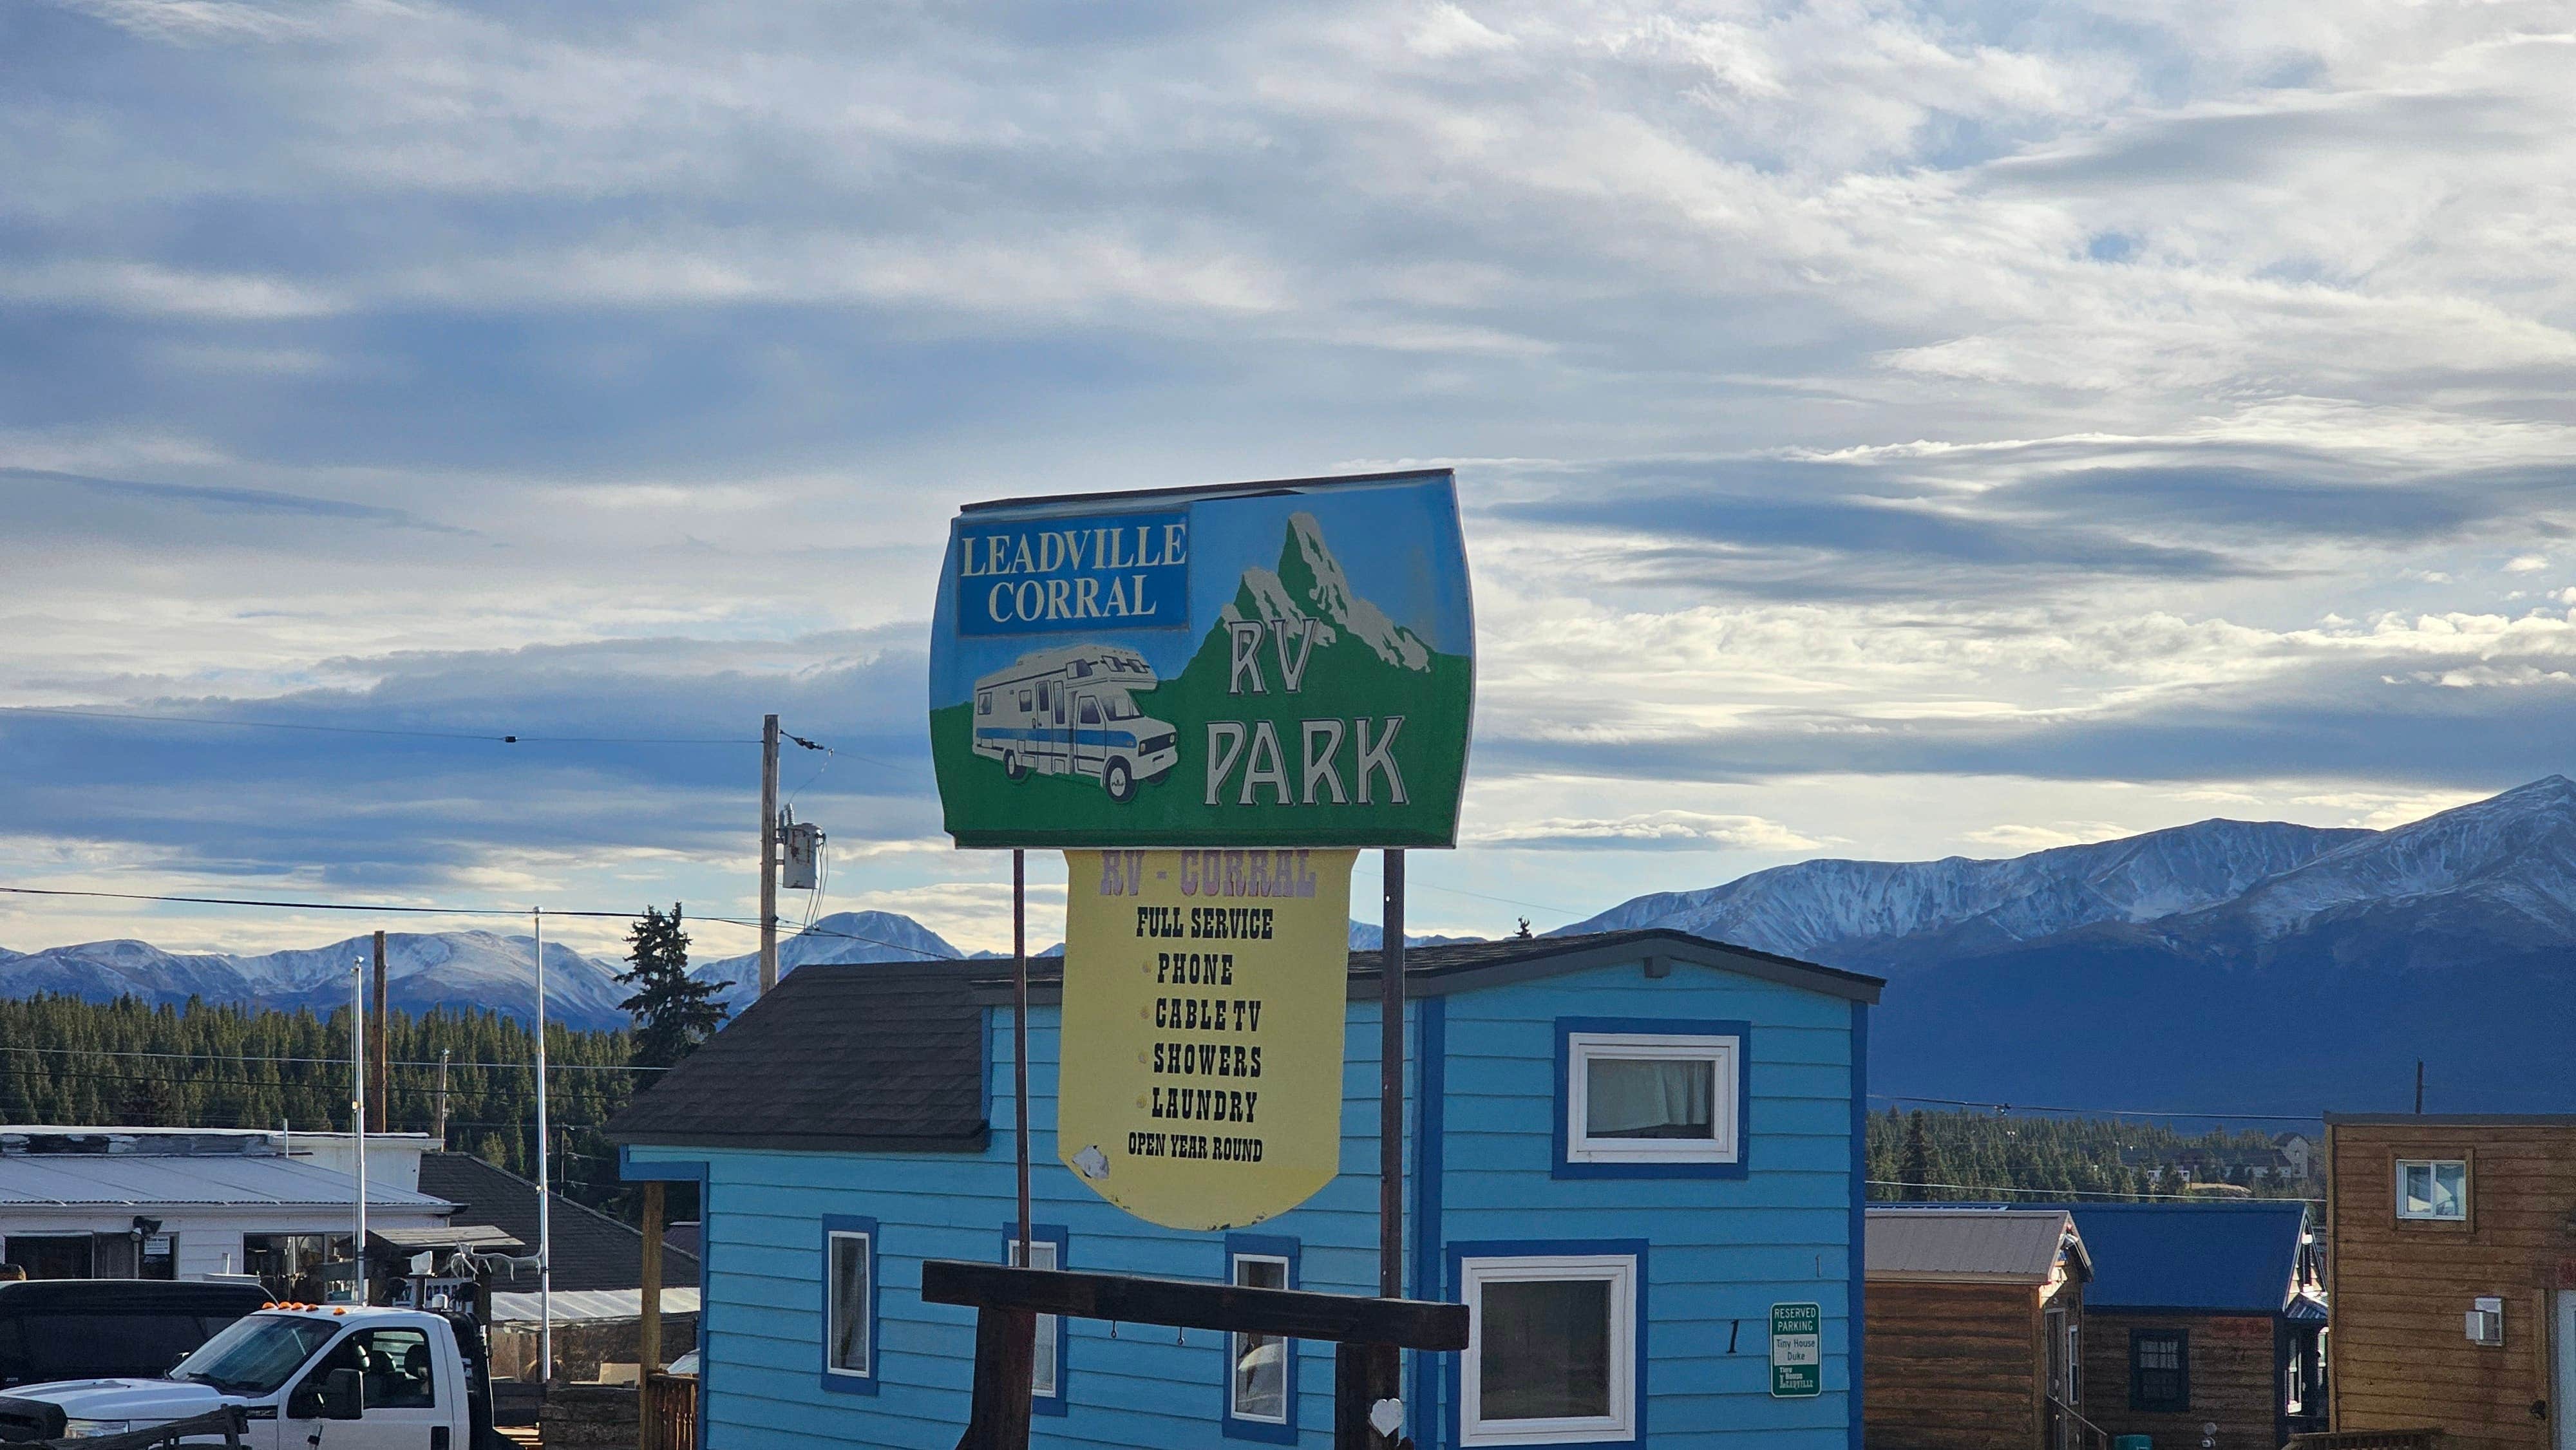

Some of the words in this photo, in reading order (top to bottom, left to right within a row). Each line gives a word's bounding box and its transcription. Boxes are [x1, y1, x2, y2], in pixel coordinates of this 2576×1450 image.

[961, 523, 1187, 578] LEADVILLE
[989, 574, 1157, 623] CORRAL
[1229, 617, 1318, 695] RV
[1204, 716, 1409, 807] PARK
[1100, 850, 1146, 896] RV
[1180, 850, 1317, 898] CORRAL
[1136, 907, 1184, 938] FULL
[1191, 907, 1274, 939] SERVICE
[1157, 953, 1233, 985] PHONE
[1155, 998, 1226, 1030] CABLE
[1233, 999, 1262, 1031] TV
[1153, 1043, 1262, 1078] SHOWERS
[1151, 1087, 1258, 1123] LAUNDRY
[1128, 1132, 1166, 1158] OPEN
[1170, 1133, 1208, 1160] YEAR
[1213, 1135, 1263, 1162] ROUND
[1774, 1308, 1817, 1319] RESERVED
[1777, 1321, 1814, 1332] PARKING
[1726, 1319, 1740, 1354] 1
[1776, 1339, 1792, 1350] Tiny
[1794, 1339, 1815, 1348] House
[1787, 1351, 1805, 1361] Duke
